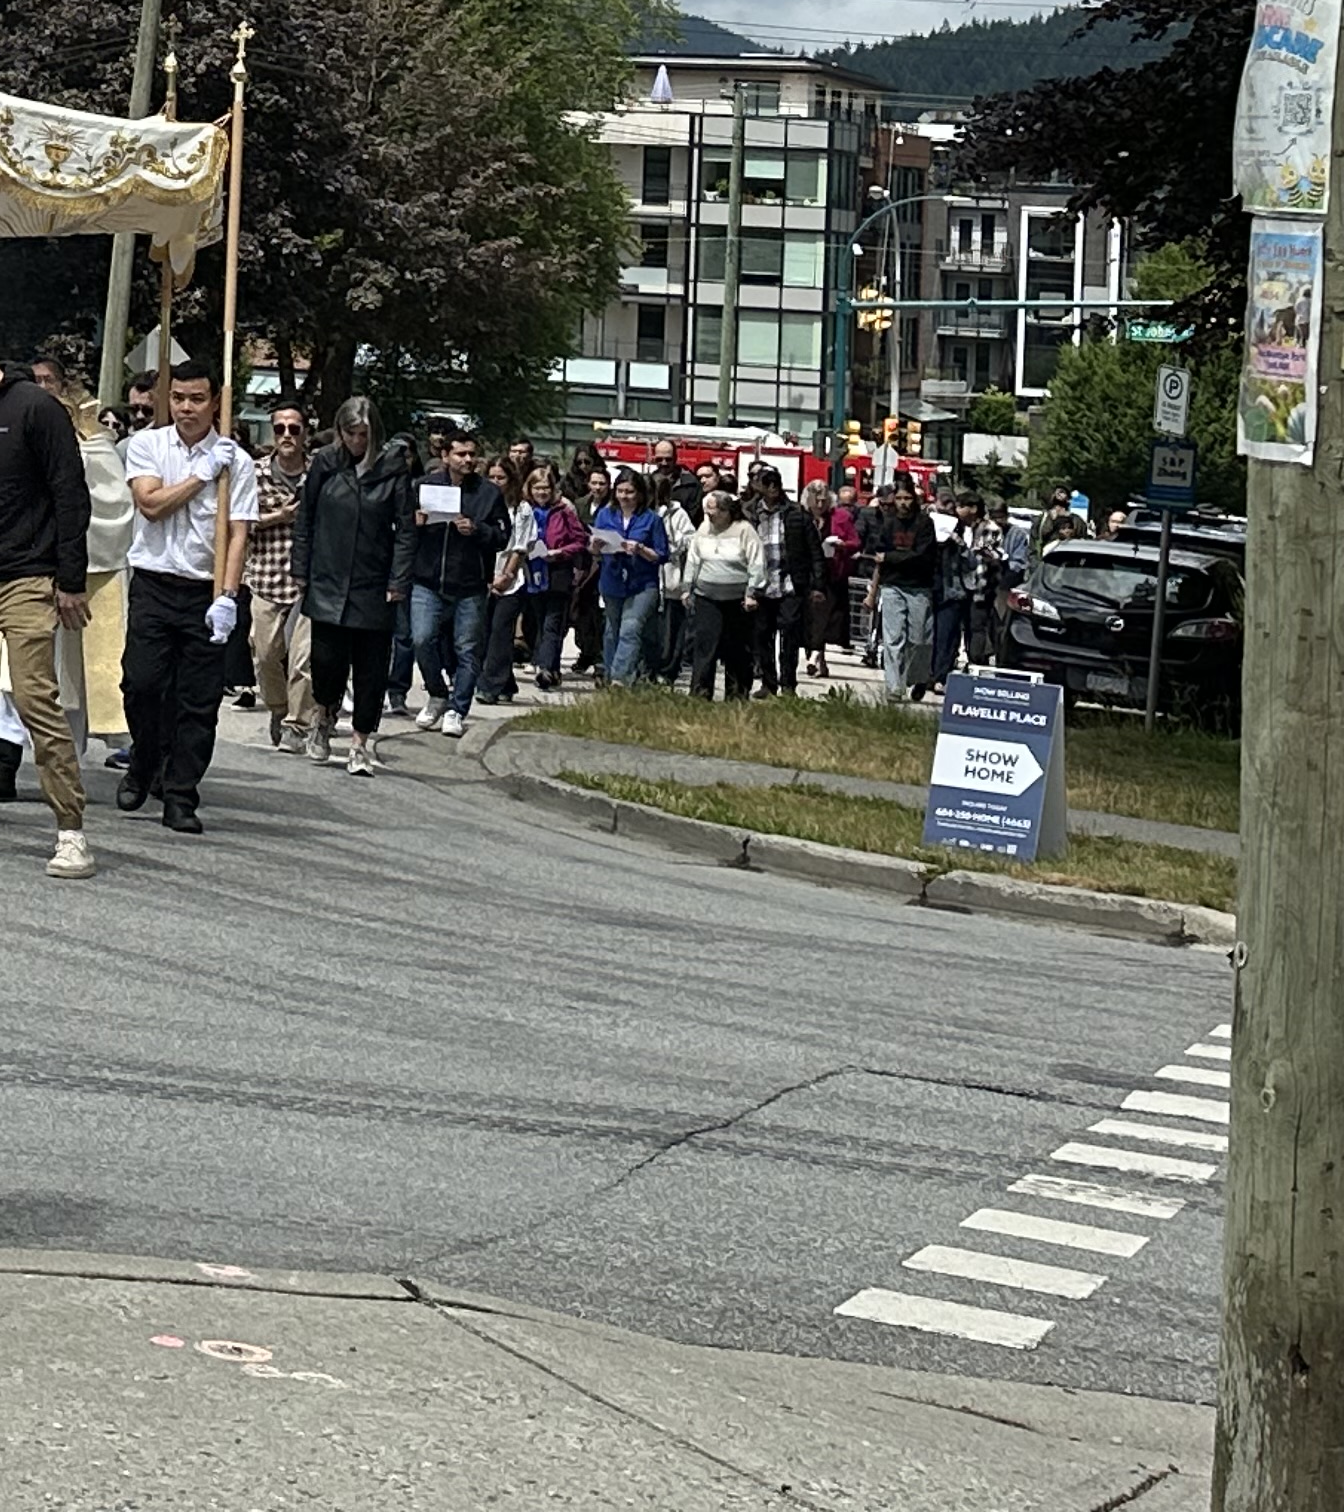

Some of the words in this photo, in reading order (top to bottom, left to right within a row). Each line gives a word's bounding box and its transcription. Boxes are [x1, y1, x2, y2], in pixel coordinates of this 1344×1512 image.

[997, 689, 1030, 701] SELLING
[951, 703, 1007, 721] FLAVELLE
[1009, 711, 1047, 726] PLACE
[965, 748, 1020, 768] SHOW
[964, 766, 1015, 784] HOME
